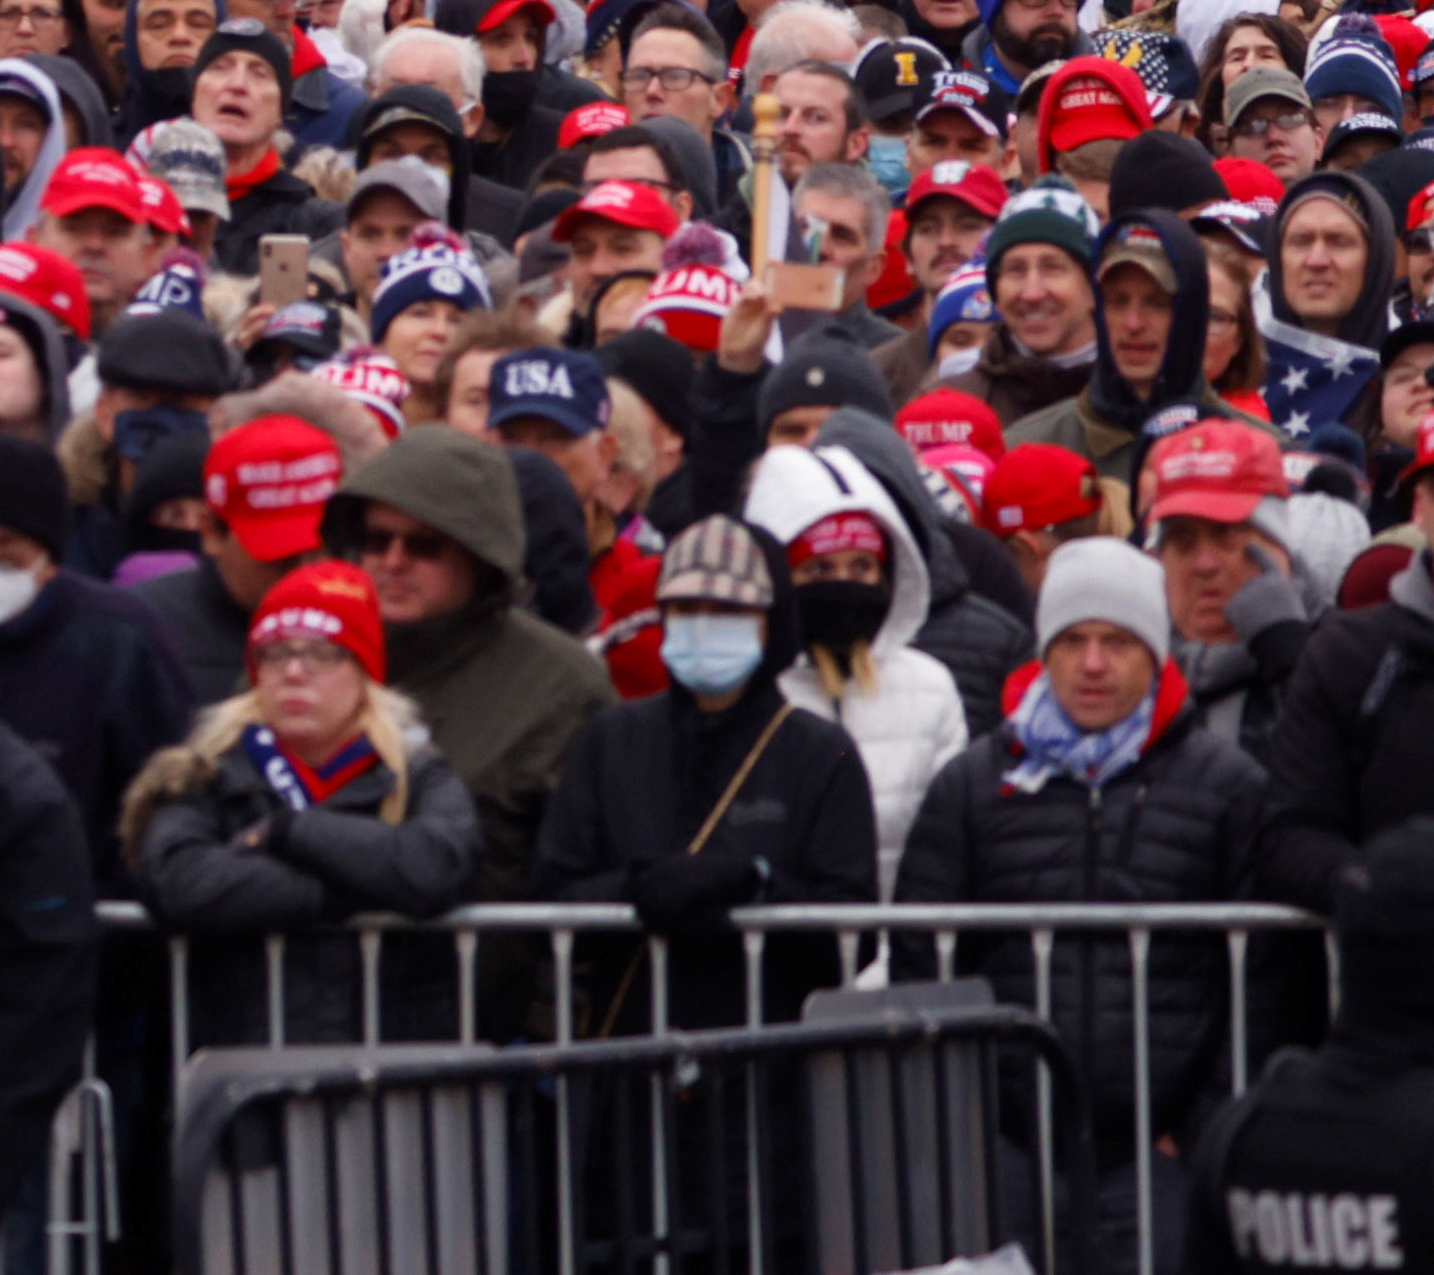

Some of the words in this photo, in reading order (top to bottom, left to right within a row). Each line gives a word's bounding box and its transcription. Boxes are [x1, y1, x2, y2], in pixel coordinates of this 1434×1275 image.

[933, 70, 990, 95] Trump
[506, 362, 576, 400] USA
[1232, 1190, 1403, 1269] POLICE
